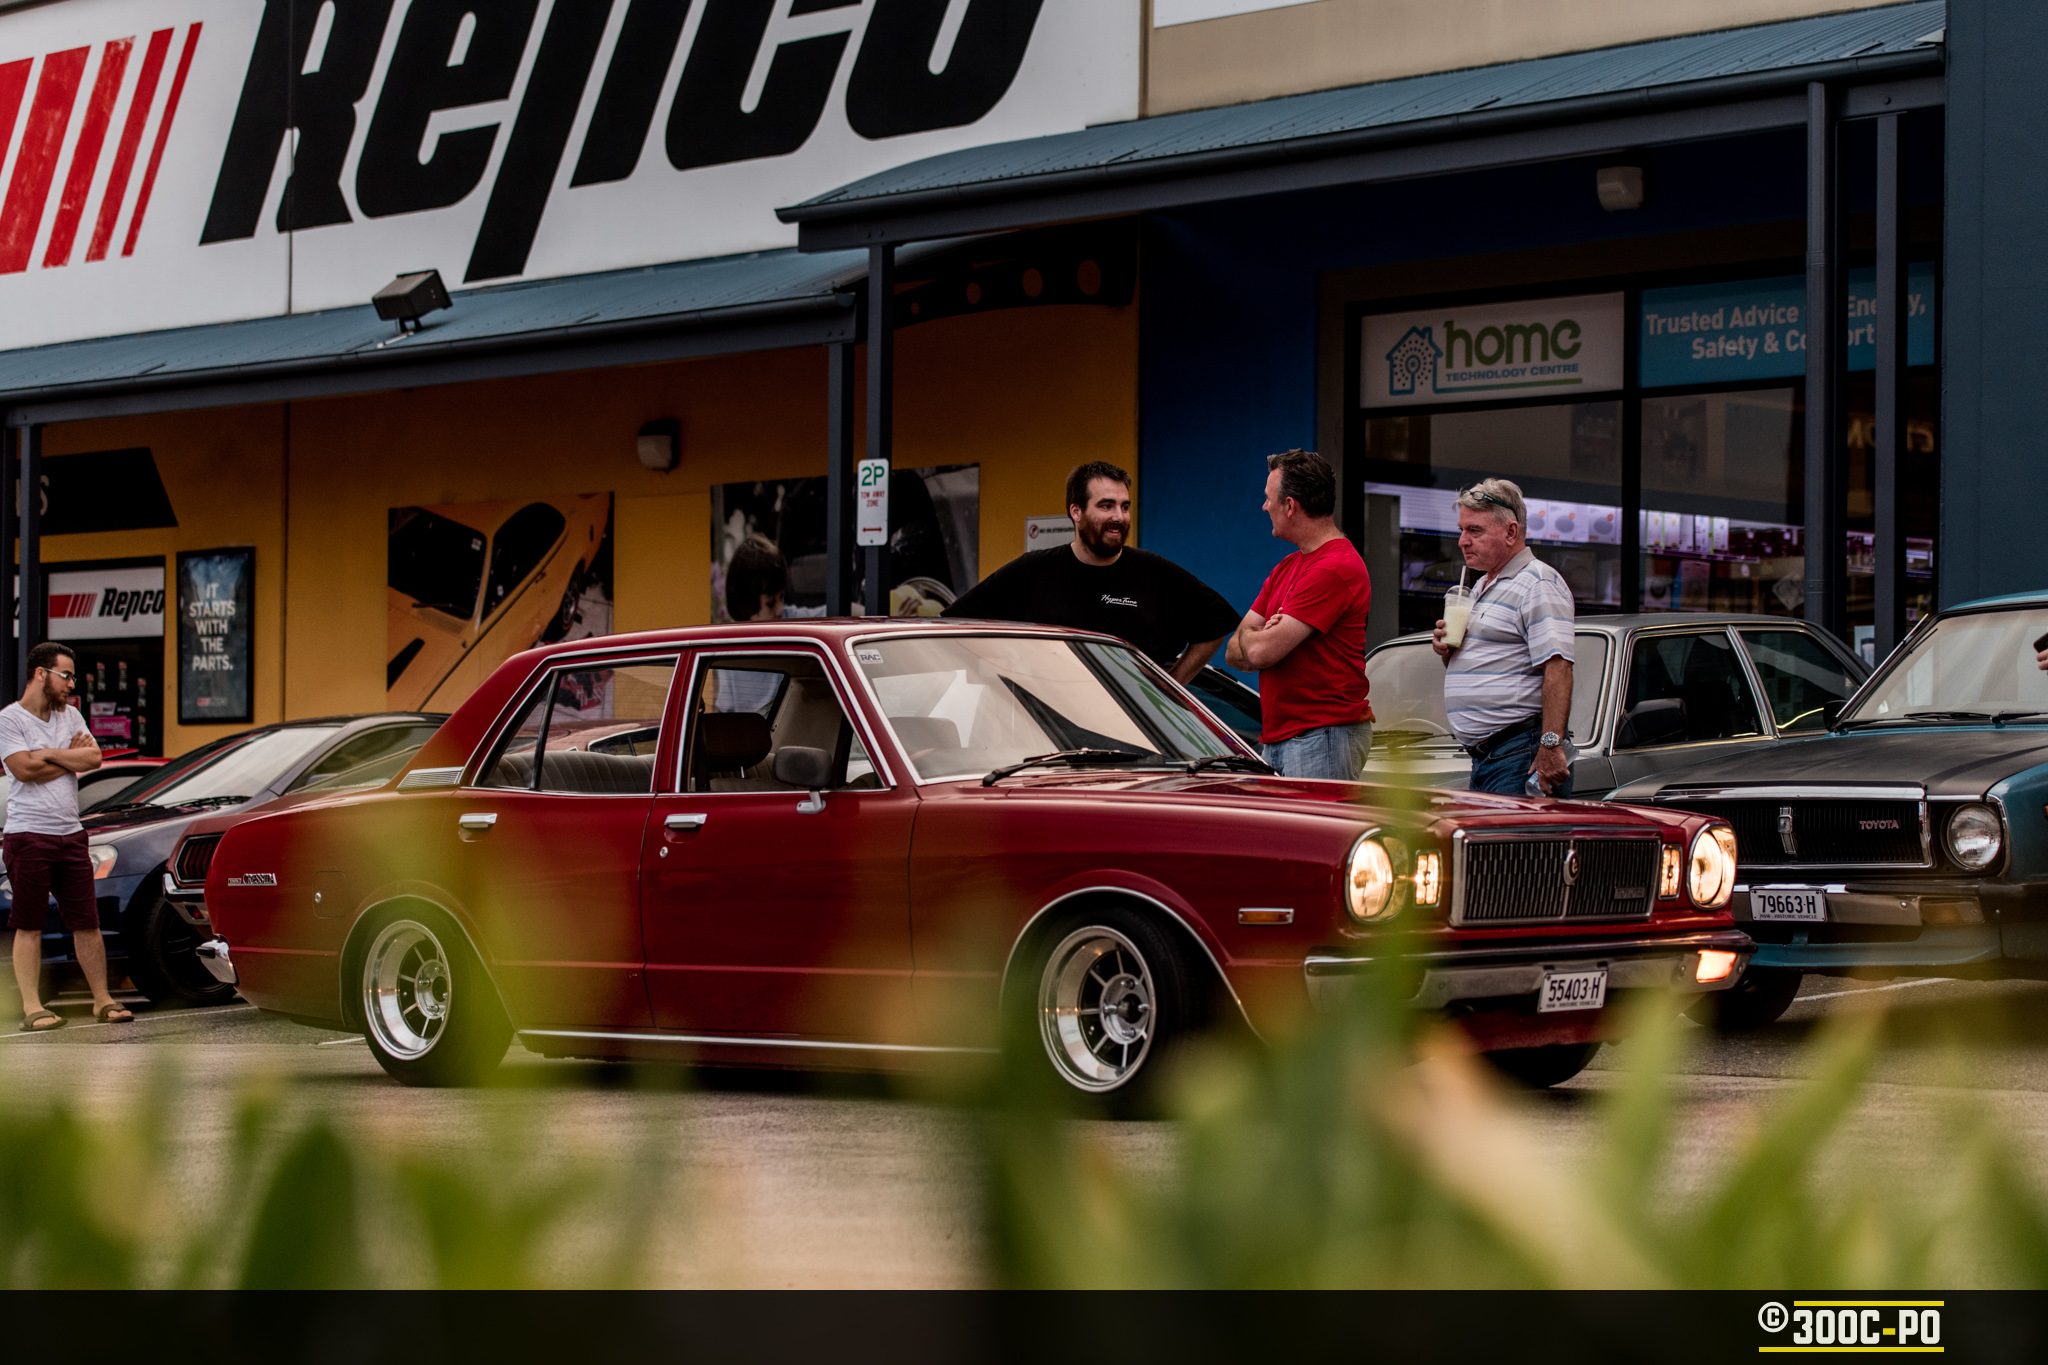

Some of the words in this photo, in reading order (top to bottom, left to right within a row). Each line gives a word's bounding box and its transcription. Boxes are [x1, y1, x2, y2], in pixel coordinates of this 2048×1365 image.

[199, 0, 1043, 283] Repco
[1645, 307, 1724, 335] Trusted
[1728, 302, 1799, 328] Advice
[1443, 319, 1582, 369] home
[1691, 334, 1759, 360] Safety
[1763, 331, 1780, 353] &
[1446, 366, 1527, 382] TECHNOLOGY
[1530, 363, 1579, 376] CENTRE
[861, 466, 885, 486] 2P
[861, 491, 870, 499] TOW
[873, 490, 885, 498] AWAY
[866, 499, 879, 507] ZONE
[206, 582, 219, 599] IT
[98, 588, 165, 622] Repco
[189, 600, 236, 617] STARTS
[195, 618, 229, 635] WITH
[200, 636, 225, 653] THE
[191, 654, 234, 671] PARTS.
[1859, 820, 1899, 830] TOYOTA
